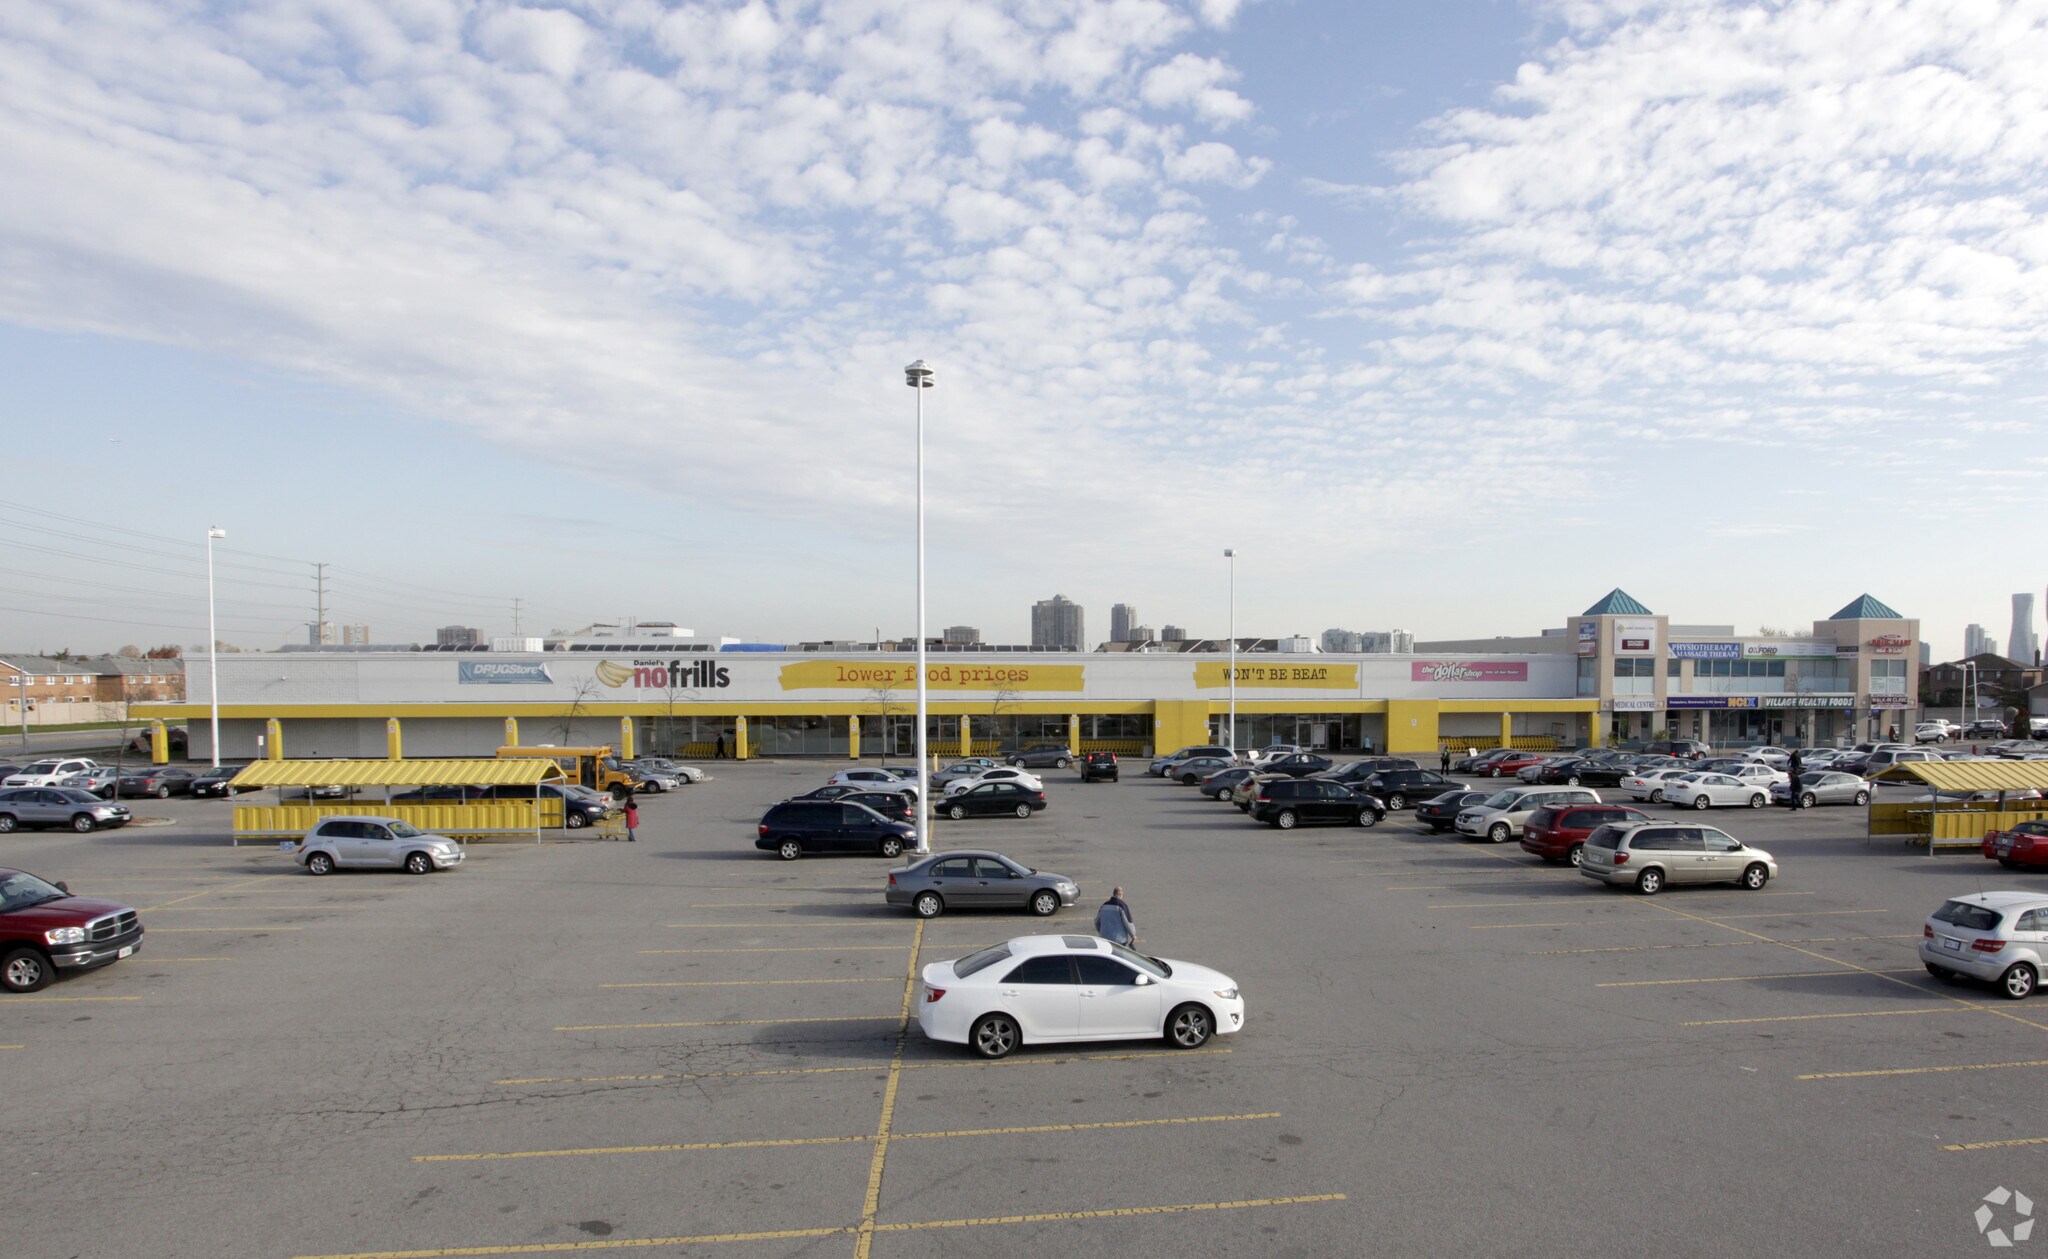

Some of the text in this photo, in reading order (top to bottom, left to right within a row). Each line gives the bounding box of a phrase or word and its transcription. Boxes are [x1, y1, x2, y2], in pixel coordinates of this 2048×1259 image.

[1672, 643, 1732, 651] PHYSIOTHERAPY
[1748, 646, 1778, 654] OXFORD
[837, 665, 1030, 685] lower fod prices
[1222, 668, 1328, 680] WON'T BE BEAT
[1421, 663, 1483, 680] the dollar shop
[1614, 700, 1656, 709] MEDICAL CENTRE
[1728, 697, 1756, 707] NCIX
[1766, 697, 1853, 707] VILLAGE HEALTH FOODS
